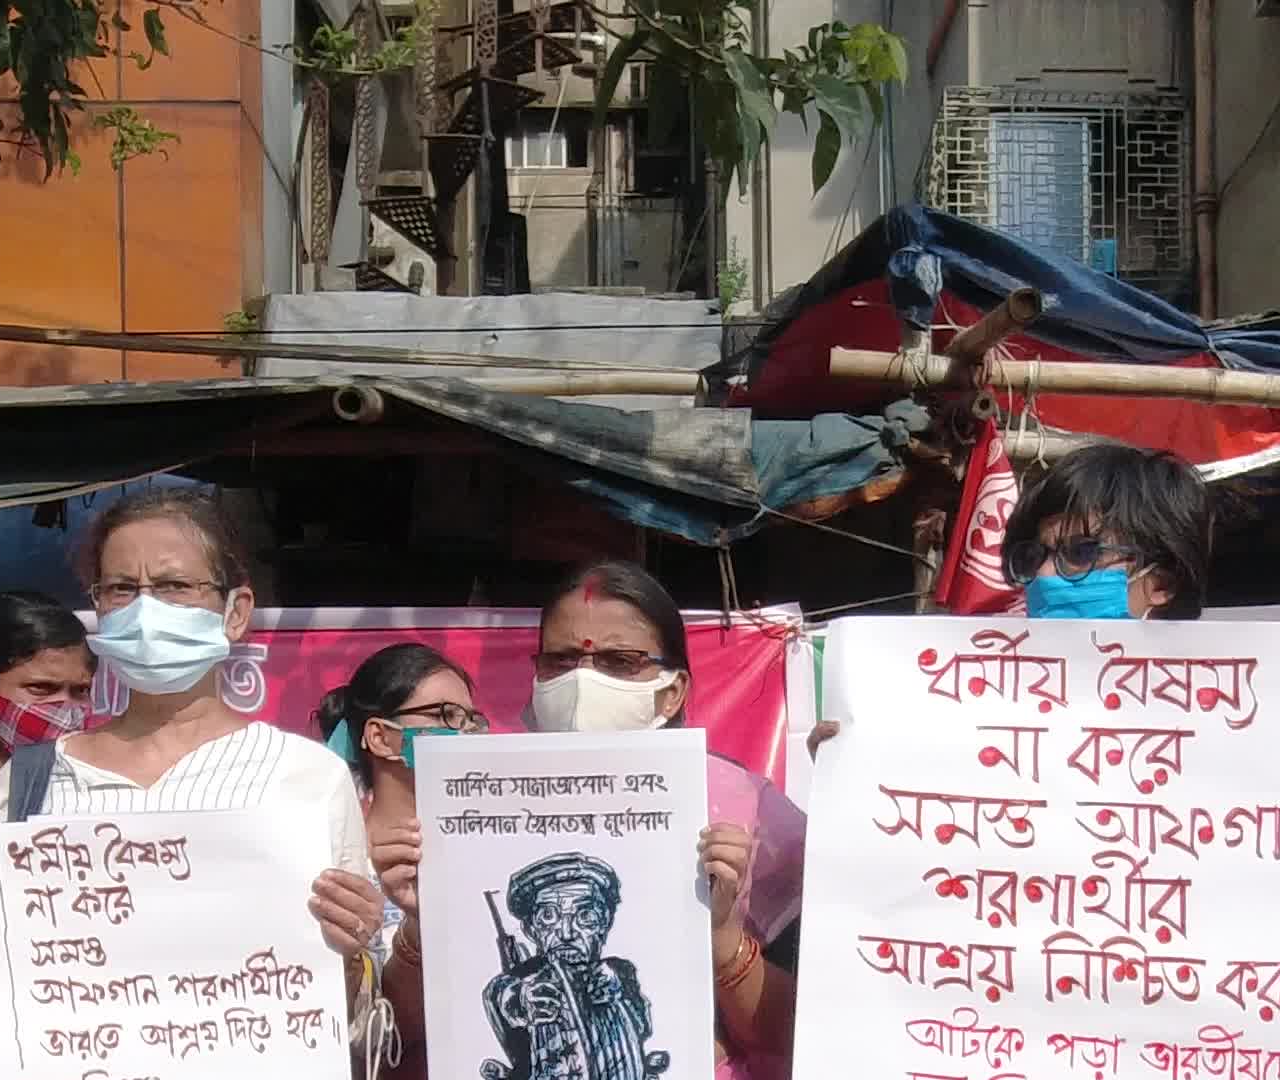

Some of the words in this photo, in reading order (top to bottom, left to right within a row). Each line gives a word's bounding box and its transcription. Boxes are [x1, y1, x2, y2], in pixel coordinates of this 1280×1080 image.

[917, 627, 1070, 715] ধর্মীয়
[1090, 629, 1260, 731] বৈষম্য
[443, 772, 504, 797] মার্কিন
[622, 773, 668, 793] এবং
[975, 725, 1050, 785] না
[1066, 725, 1197, 796] করে
[436, 808, 521, 836] তালিবান
[871, 783, 1049, 849] সমস্ত
[6, 823, 97, 882] ধর্মীয়
[96, 824, 192, 881] বৈষম্য
[24, 886, 61, 928] না
[70, 884, 136, 926] করে
[921, 849, 1193, 952] শরণার্থীর
[30, 936, 108, 968] সমস্ত
[856, 934, 1018, 1004] আশ্রয়
[1039, 924, 1207, 1006] নিশ্চিত
[31, 978, 159, 1014] আফগান
[40, 1024, 120, 1060] ভারতে
[139, 1019, 219, 1061] আশ্রয়
[225, 1008, 272, 1053] দিতে
[904, 1006, 1025, 1071] আটকে
